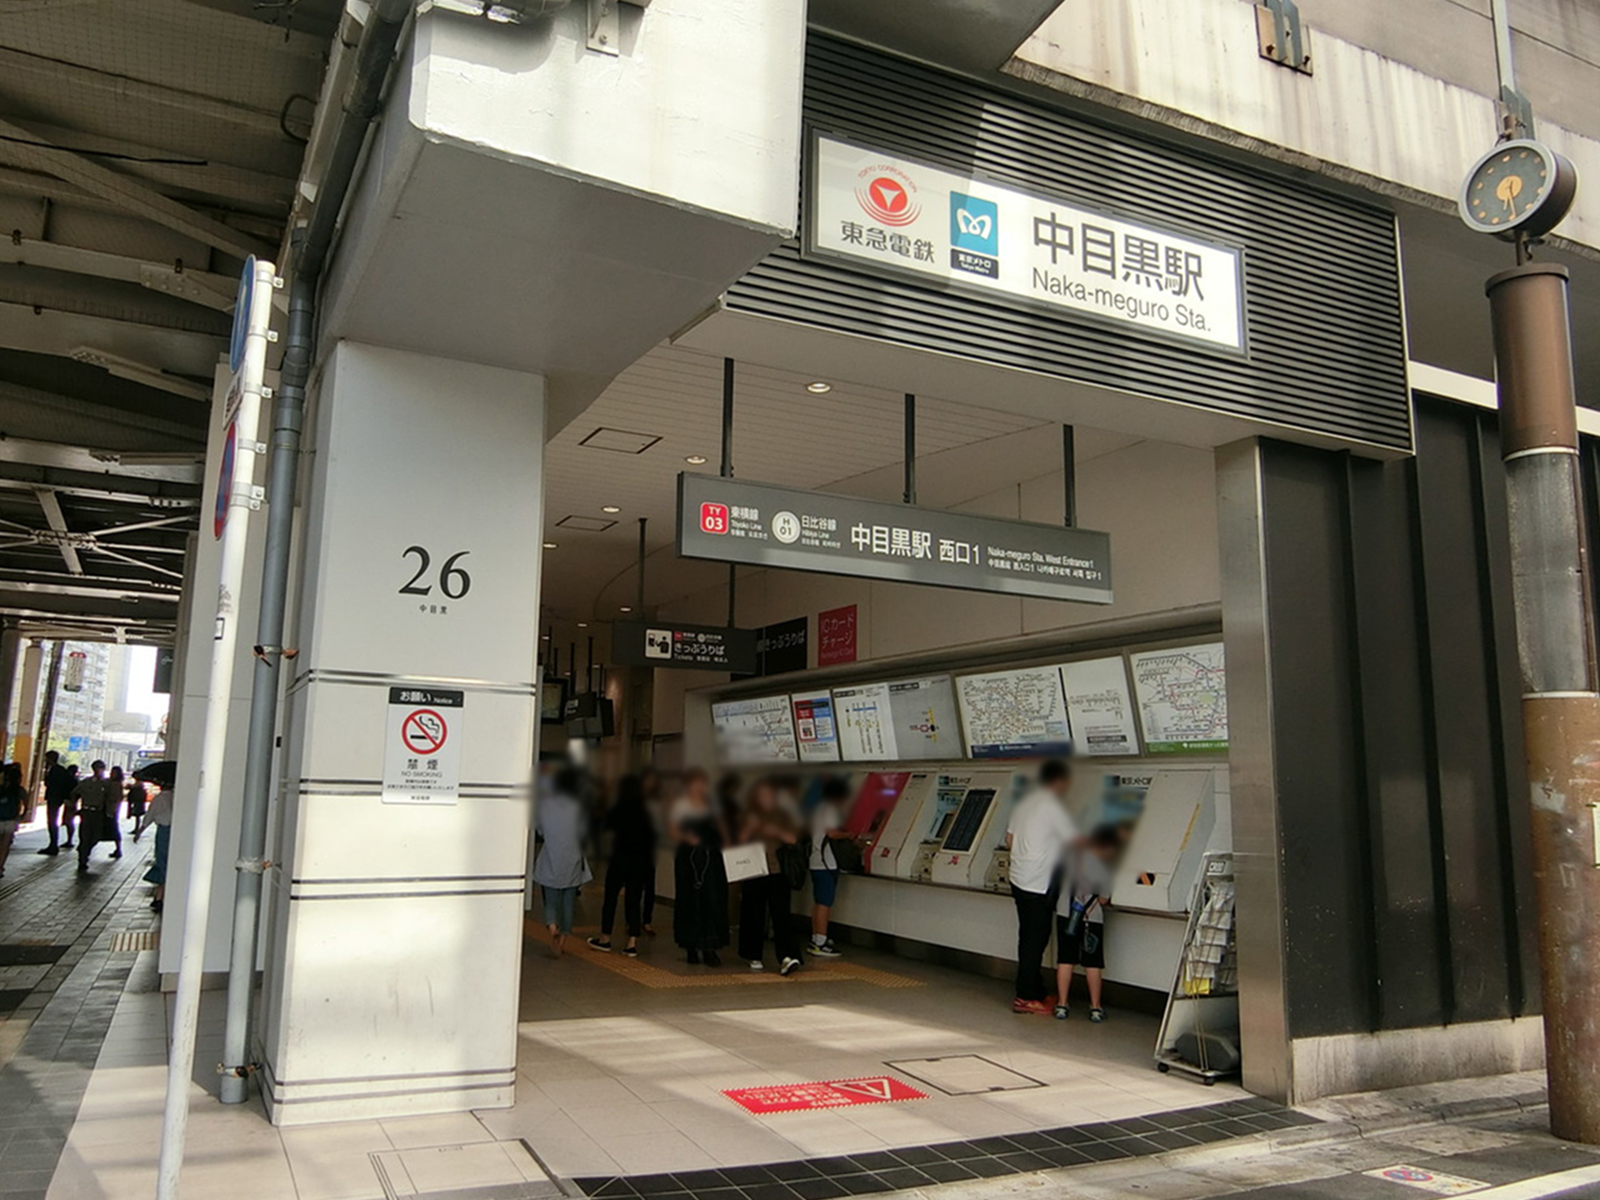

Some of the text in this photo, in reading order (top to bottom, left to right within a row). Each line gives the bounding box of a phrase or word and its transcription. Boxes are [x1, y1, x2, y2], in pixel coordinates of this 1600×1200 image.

[841, 220, 936, 264] 東急電鉄
[1033, 211, 1205, 302] 中目黒駅
[1032, 266, 1212, 333] Naka-meguro Sta.
[708, 506, 721, 515] TY
[705, 516, 723, 530] 03
[779, 525, 792, 536] 01
[801, 515, 837, 532] 日比谷線
[851, 522, 932, 560] 中目黒駅
[987, 546, 1032, 562] Naka-meguro
[398, 545, 471, 600] 26
[822, 630, 853, 649] チャージ
[674, 642, 725, 656] きっぷうりば
[399, 690, 431, 703] お願い
